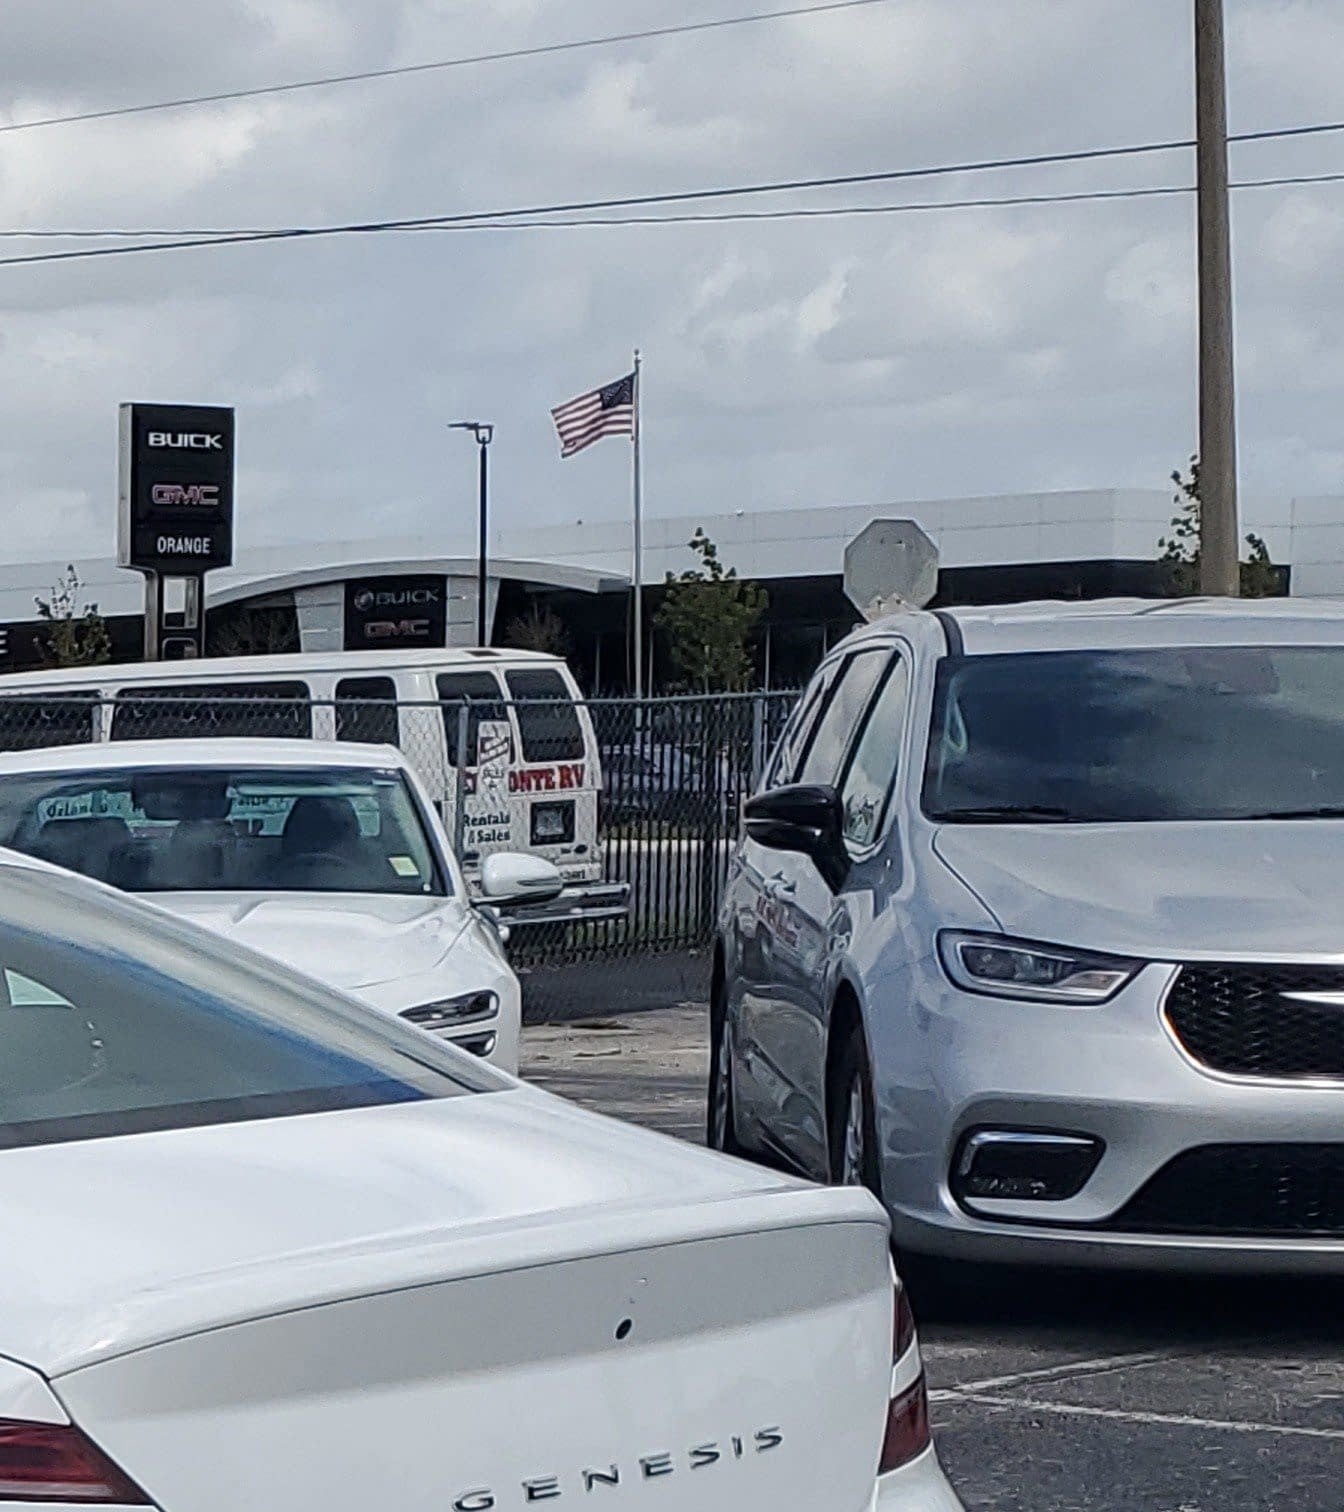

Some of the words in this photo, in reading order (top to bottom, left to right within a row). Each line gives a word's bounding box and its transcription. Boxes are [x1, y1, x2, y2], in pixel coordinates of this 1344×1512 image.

[147, 431, 223, 449] BUICK
[152, 484, 219, 505] GMC
[157, 536, 211, 554] ORANGE
[376, 588, 439, 605] BUICK
[364, 619, 430, 638] GMC
[558, 763, 585, 790] RV
[463, 811, 511, 827] Rentals
[477, 828, 511, 843] Sales
[452, 1426, 783, 1512] GENESIS
